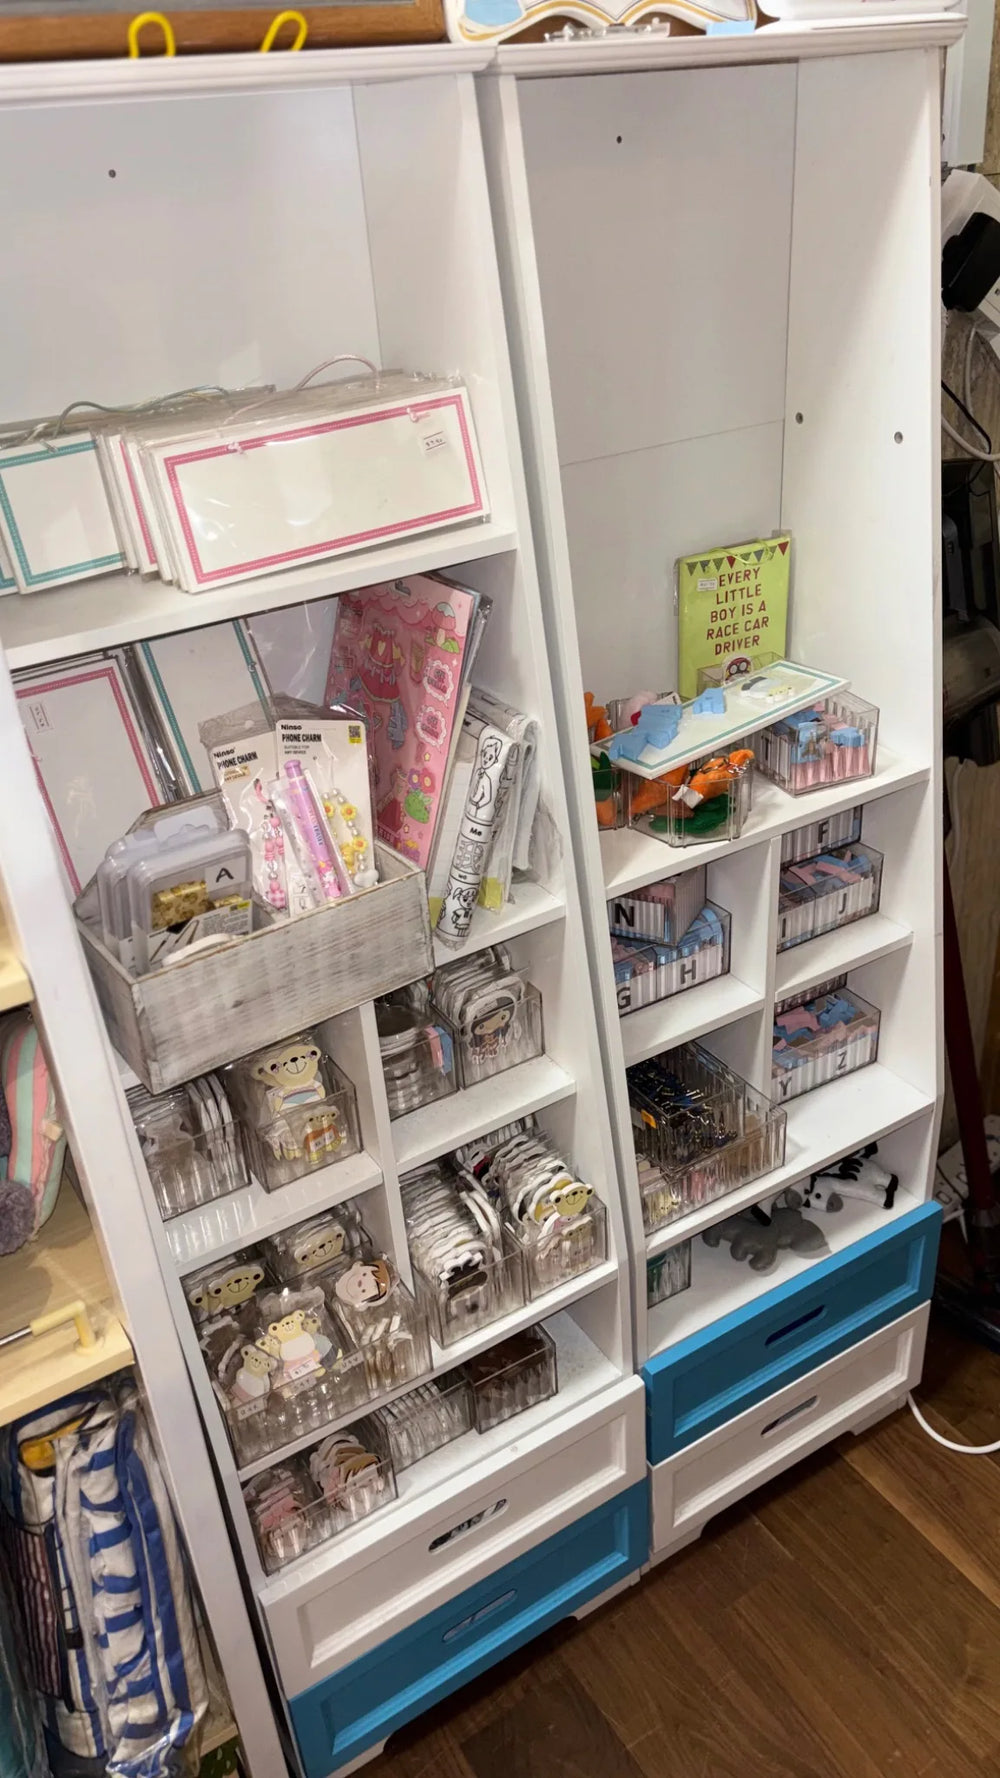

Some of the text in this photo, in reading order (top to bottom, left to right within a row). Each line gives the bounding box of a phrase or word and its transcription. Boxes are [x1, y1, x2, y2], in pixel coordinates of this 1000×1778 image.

[719, 567, 760, 587] EVERY
[716, 584, 762, 605] LITTLE
[710, 600, 766, 623] BOY IS A
[706, 616, 769, 640] RACE CAR
[715, 635, 760, 656] DRIVER
[282, 733, 322, 742] PHONE CHARM
[213, 749, 235, 758] Ninso
[217, 751, 258, 769] PHONE CHARM
[470, 827, 482, 836] Me
[818, 820, 829, 843] F
[216, 868, 234, 883] A
[839, 893, 847, 915] J
[614, 903, 635, 927] N
[680, 959, 696, 984] H
[617, 987, 631, 1009] G
[838, 1050, 847, 1070] Z
[779, 1076, 792, 1096] Y
